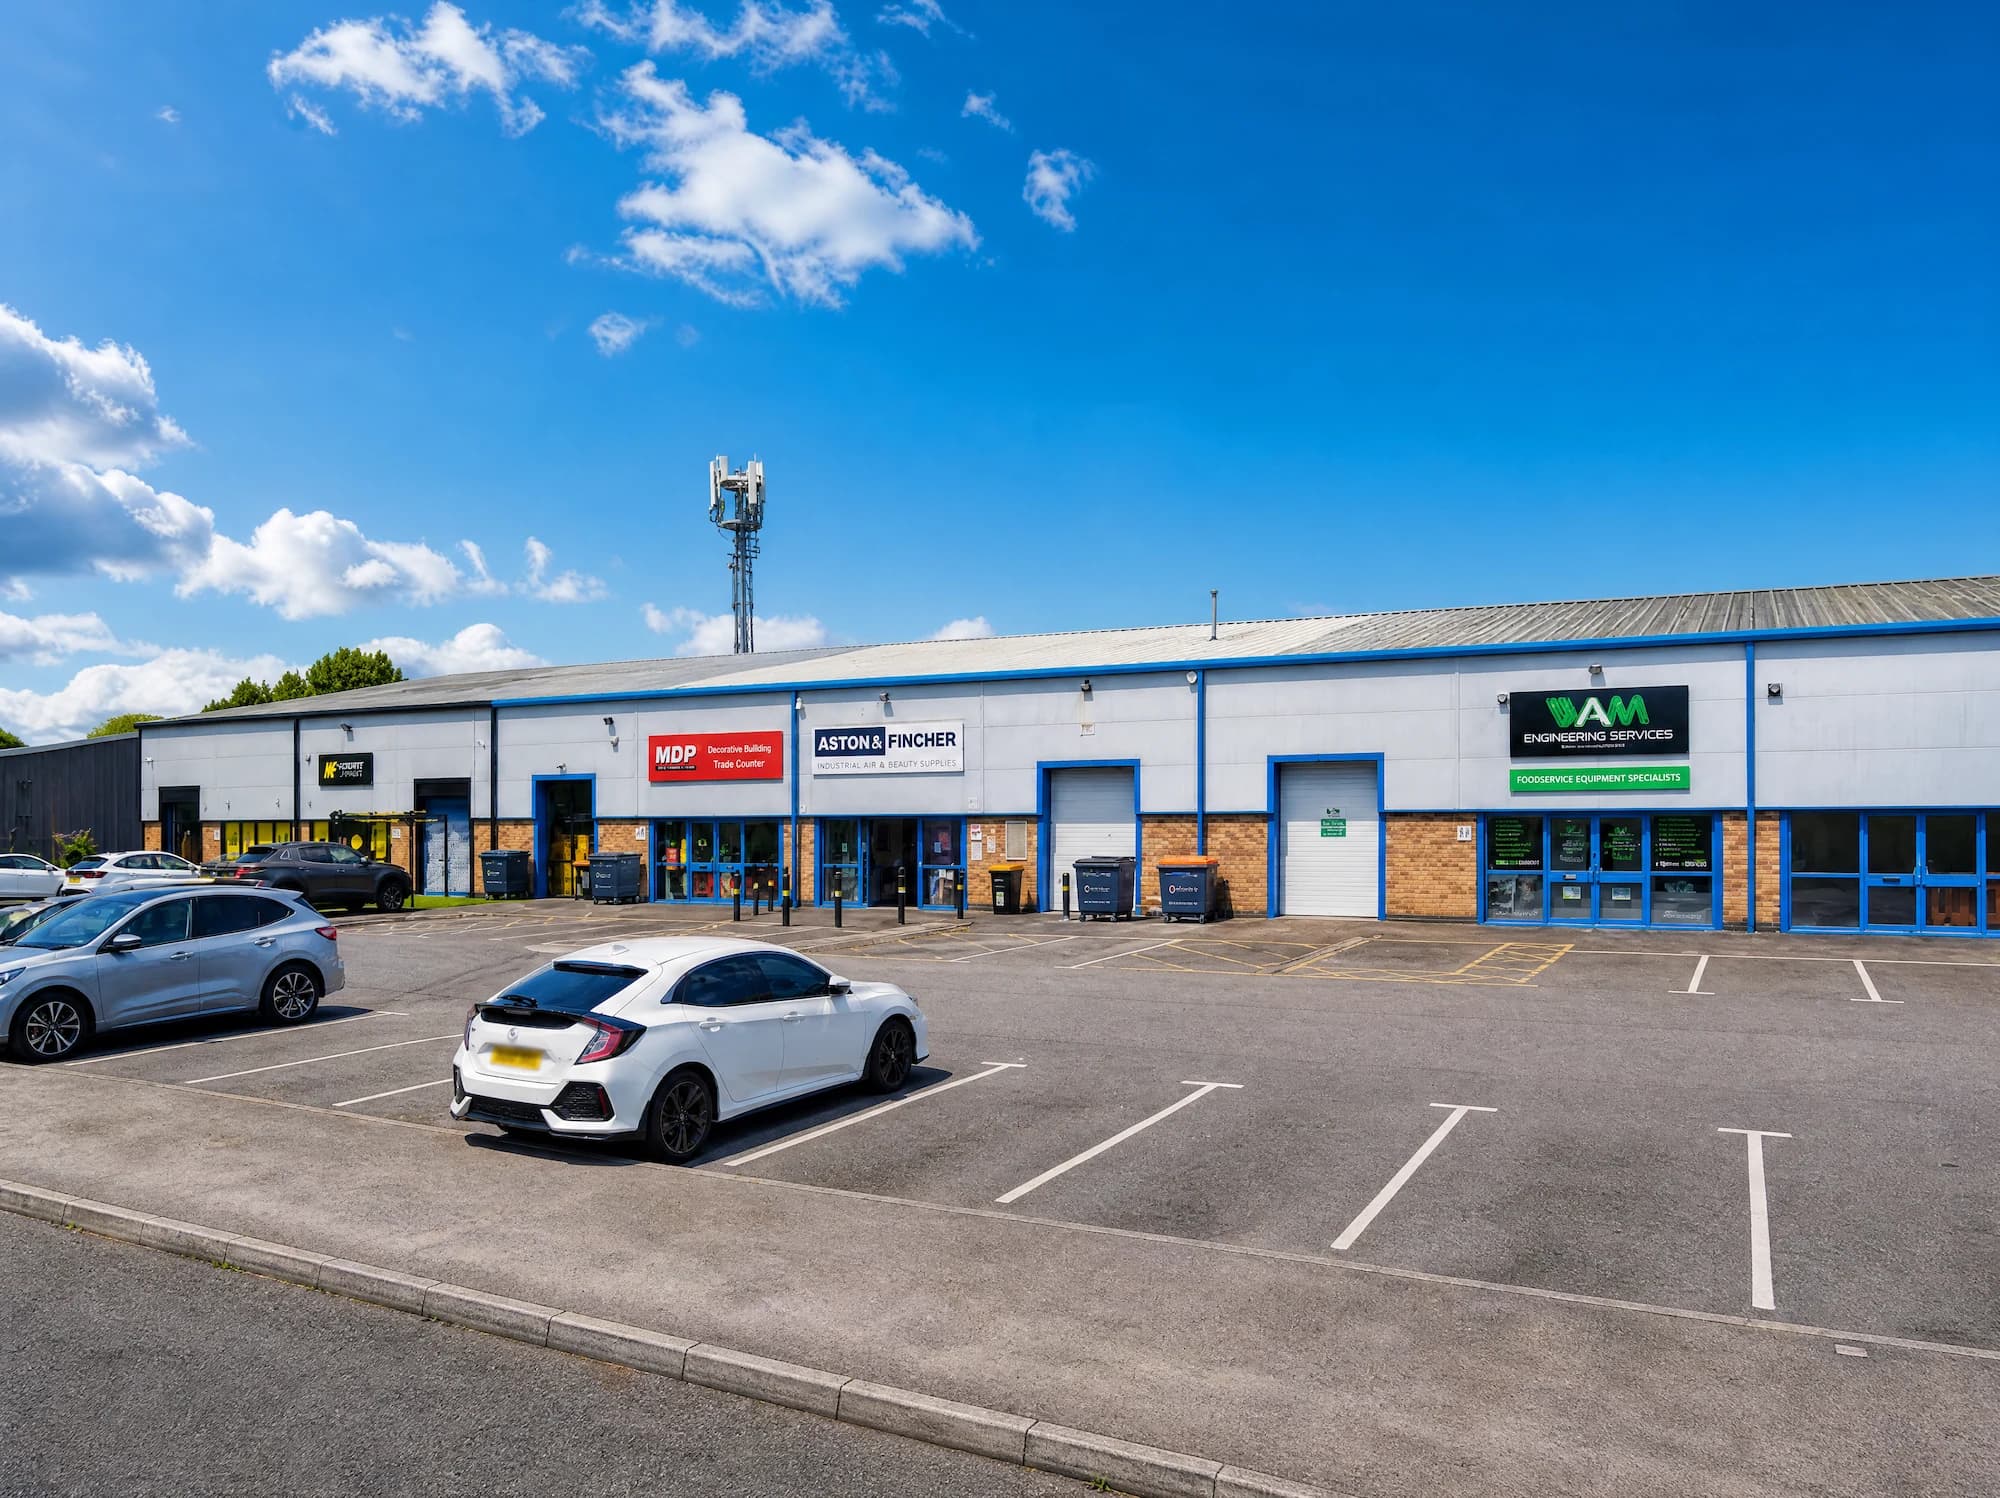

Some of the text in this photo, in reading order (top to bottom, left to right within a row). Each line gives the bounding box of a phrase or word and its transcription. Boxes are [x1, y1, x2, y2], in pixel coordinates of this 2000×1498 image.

[888, 732, 957, 749] FINCHER
[1523, 729, 1674, 744] ENGINEERING SERVICES
[655, 744, 697, 764] MDP
[707, 744, 743, 754] Decorative
[713, 758, 766, 769] Trade Counter
[817, 761, 861, 770] INDUSTRIAL
[888, 761, 917, 769] BEAUTY
[919, 759, 957, 768] SUPPLIES
[1516, 772, 1681, 785] FOODSERVICE EQUIPMENT SPECIALISTS
